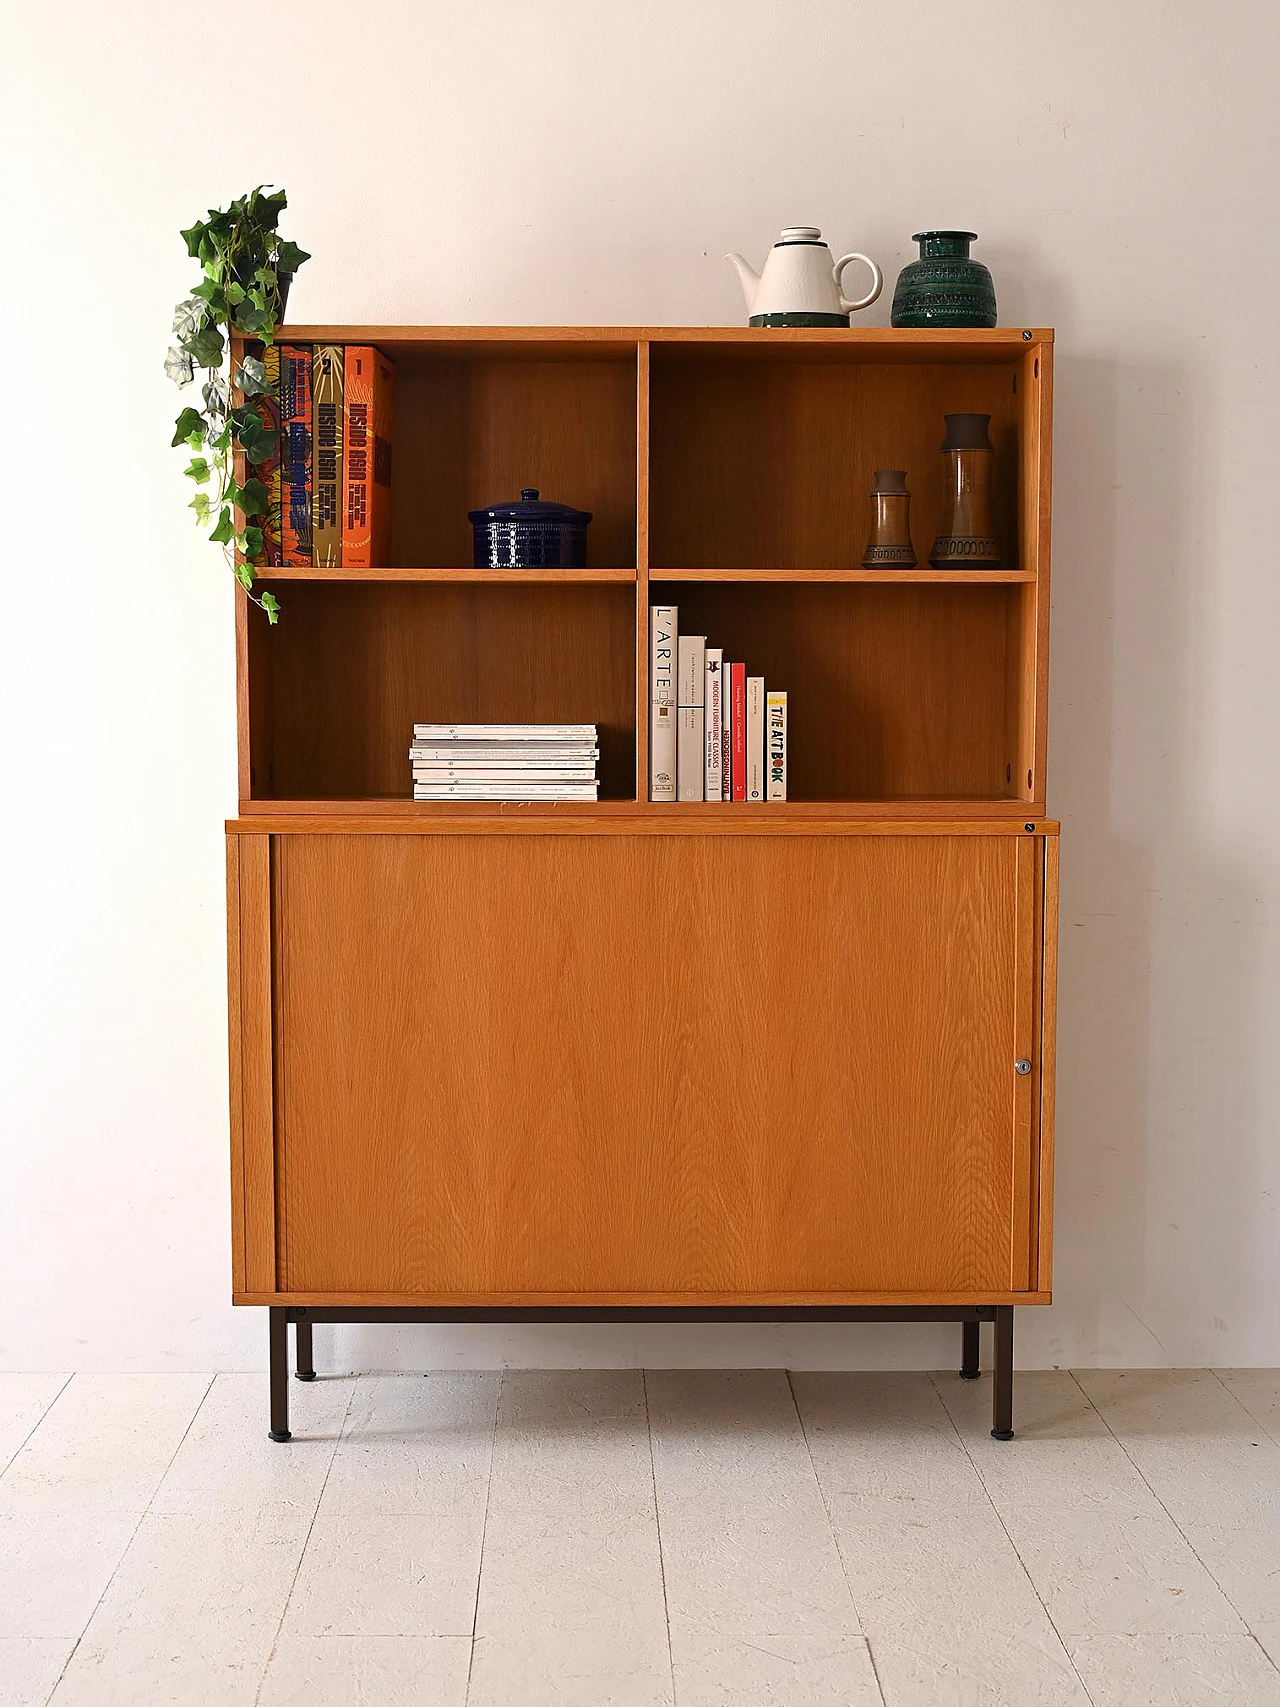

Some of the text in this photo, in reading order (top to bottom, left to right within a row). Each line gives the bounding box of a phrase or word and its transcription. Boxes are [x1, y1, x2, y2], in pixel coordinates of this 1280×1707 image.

[322, 358, 332, 376] 2
[355, 358, 362, 376] 1
[656, 609, 672, 688] L'ARTE
[771, 706, 784, 728] THE
[771, 729, 784, 751] ART
[771, 752, 784, 783] BOOK
